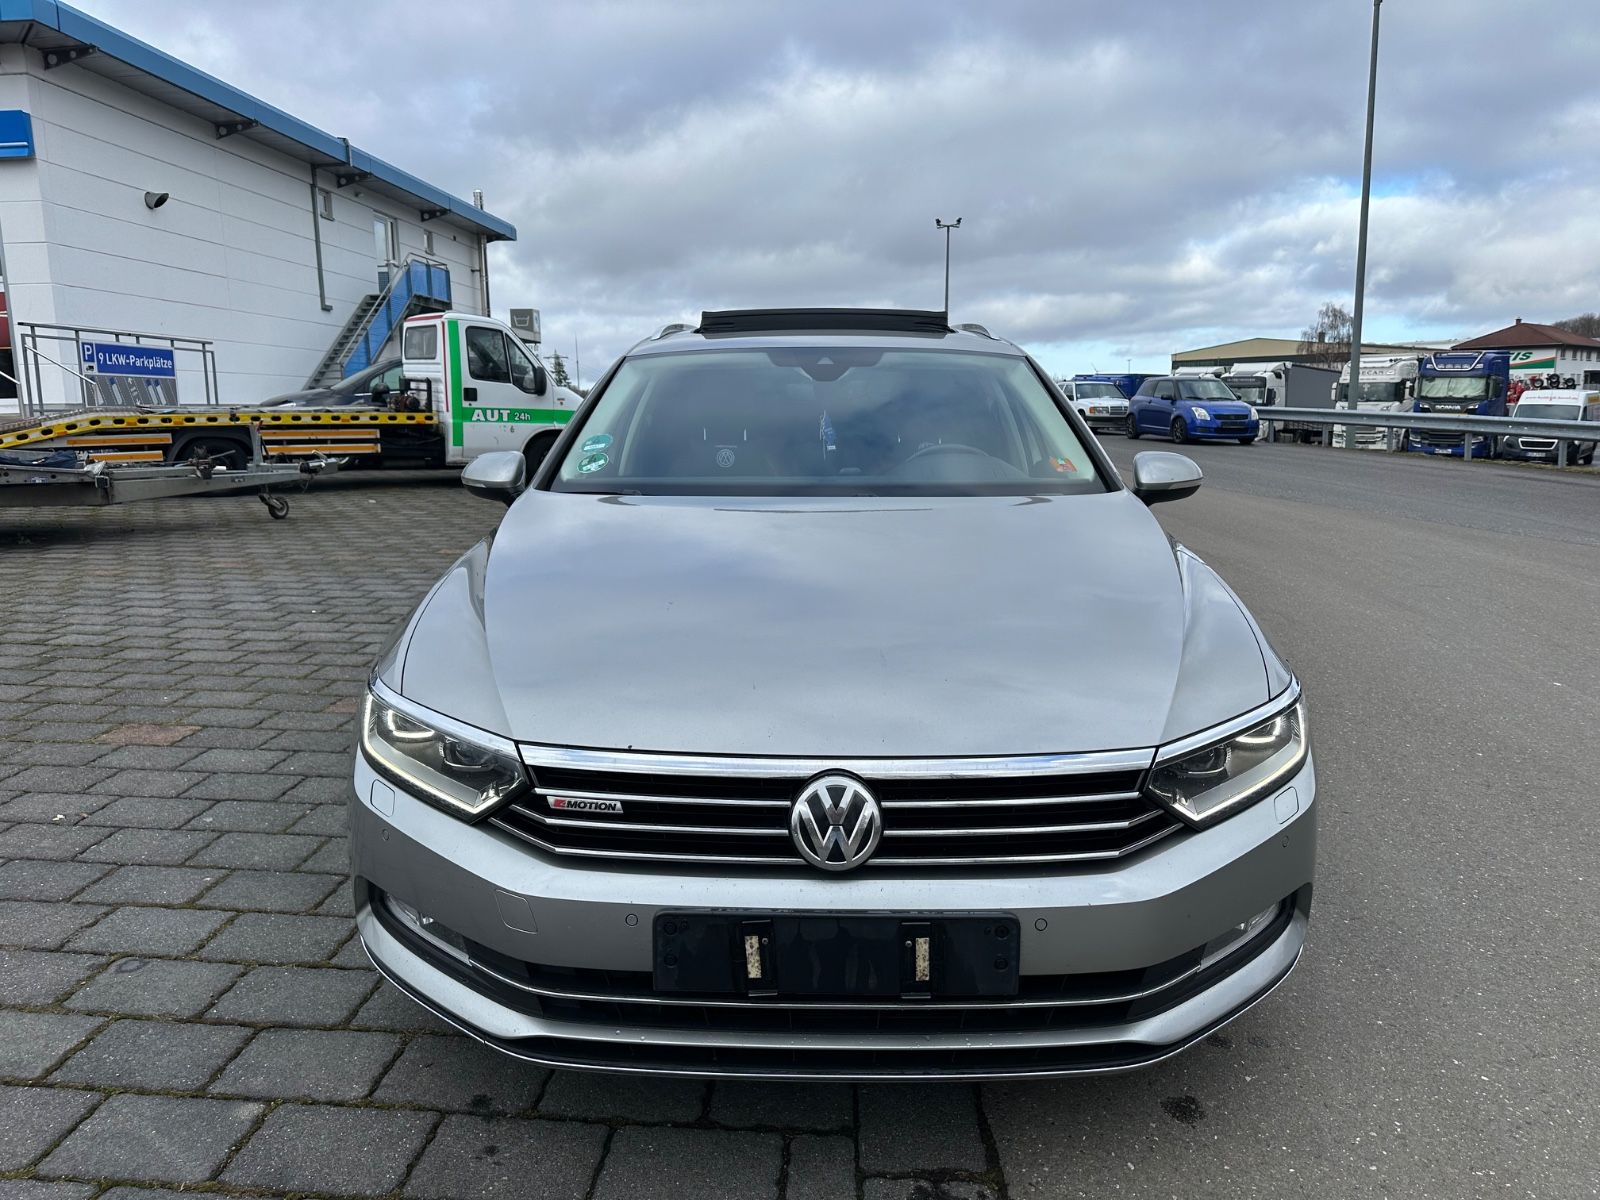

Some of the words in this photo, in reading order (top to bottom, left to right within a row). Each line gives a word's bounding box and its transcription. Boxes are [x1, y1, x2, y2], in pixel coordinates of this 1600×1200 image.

[84, 344, 92, 360] P
[98, 352, 104, 364] 9
[106, 353, 172, 369] LKW-Parkplätze
[472, 409, 510, 422] AUT
[514, 412, 531, 421] 24h
[792, 776, 880, 871] VW
